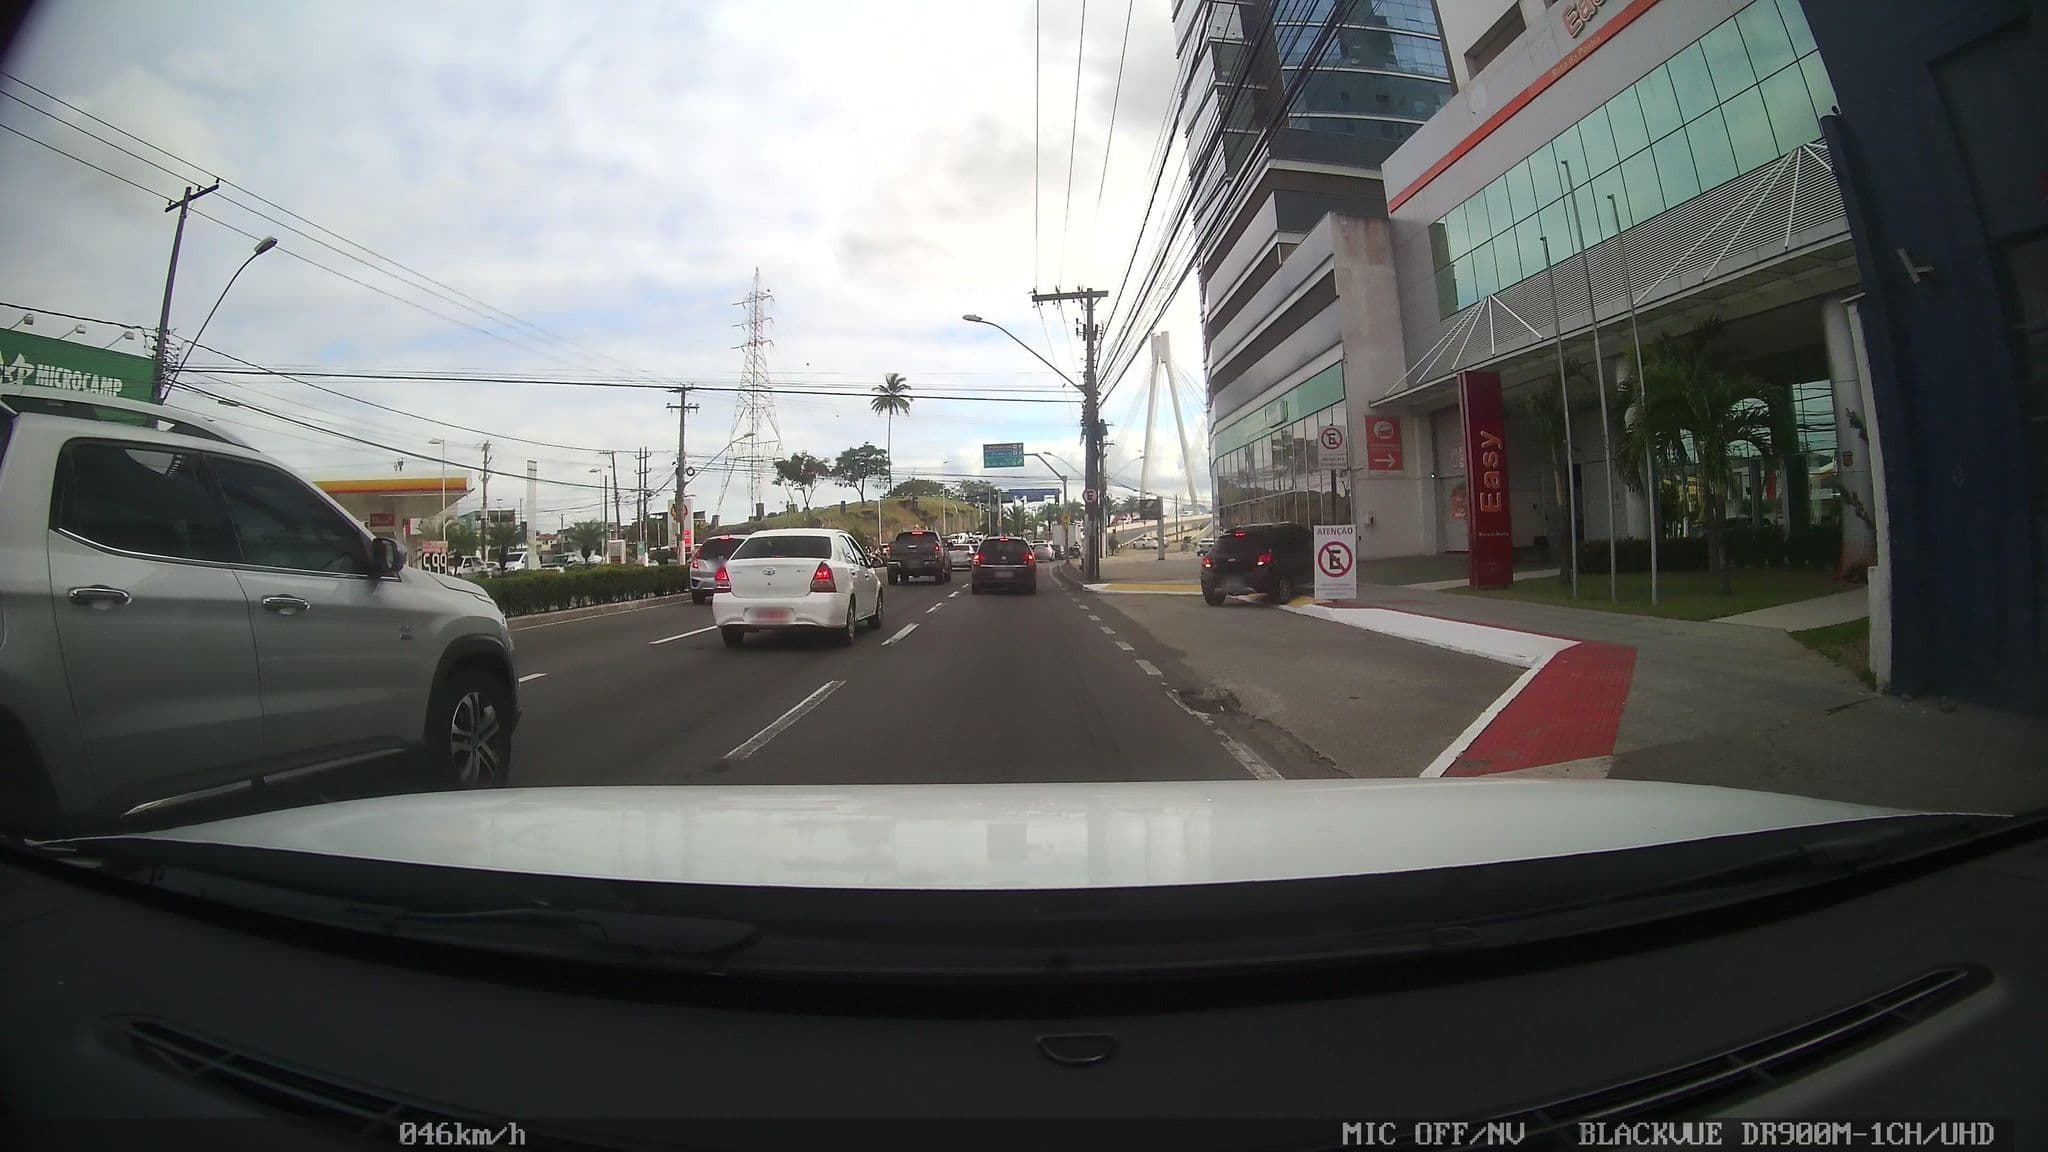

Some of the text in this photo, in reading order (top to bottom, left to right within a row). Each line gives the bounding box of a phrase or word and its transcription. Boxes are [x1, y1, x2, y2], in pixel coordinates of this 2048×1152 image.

[1561, 0, 1605, 38] Ea
[35, 363, 123, 397] MICROCAMP
[1480, 430, 1503, 512] Easy
